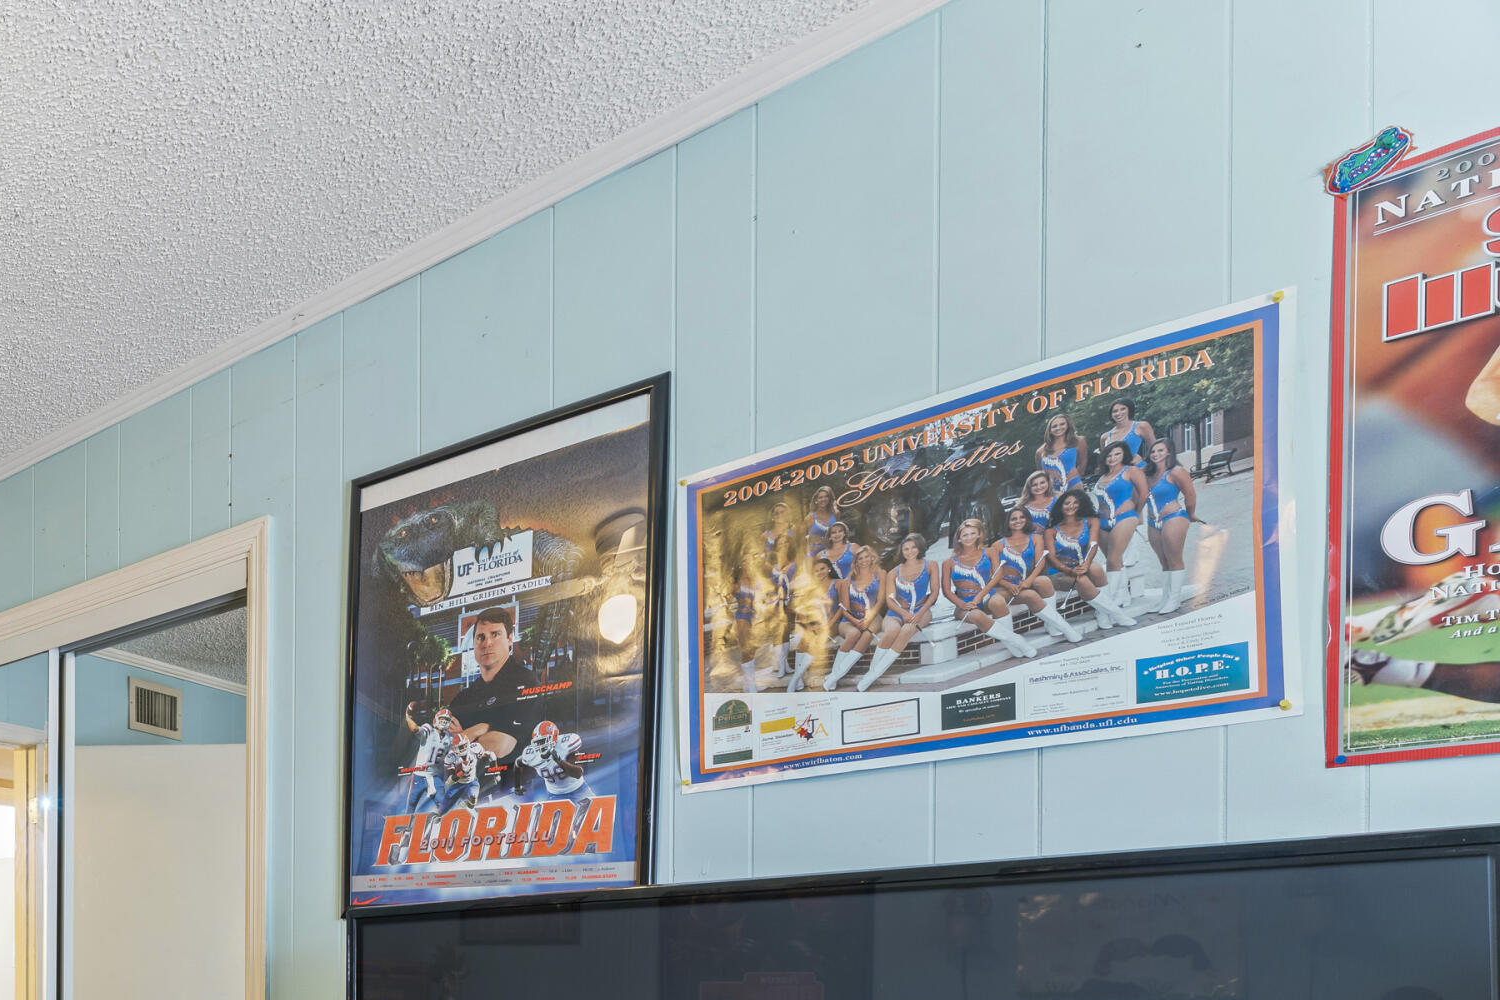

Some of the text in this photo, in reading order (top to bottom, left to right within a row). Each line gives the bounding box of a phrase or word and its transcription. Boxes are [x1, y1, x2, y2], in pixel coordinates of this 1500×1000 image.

[724, 350, 1215, 507] 2004-2005 UNIVERSITY OF FLORIDA
[837, 440, 1024, 507] Gatorettes
[457, 555, 523, 577] UF FLORIDA
[448, 598, 468, 607] HILL
[473, 588, 506, 600] GRIFFIN
[511, 578, 551, 592] STADIUM
[1450, 626, 1482, 638] And
[1156, 660, 1230, 680] H.O.P.E.
[522, 681, 572, 695] MUSCHAMP
[956, 693, 1001, 705] BANKERS
[1028, 717, 1138, 736] www.ufbands.ufl.edu
[373, 795, 617, 867] FLORIDA
[419, 830, 551, 850] 2011 FOOTBALL
